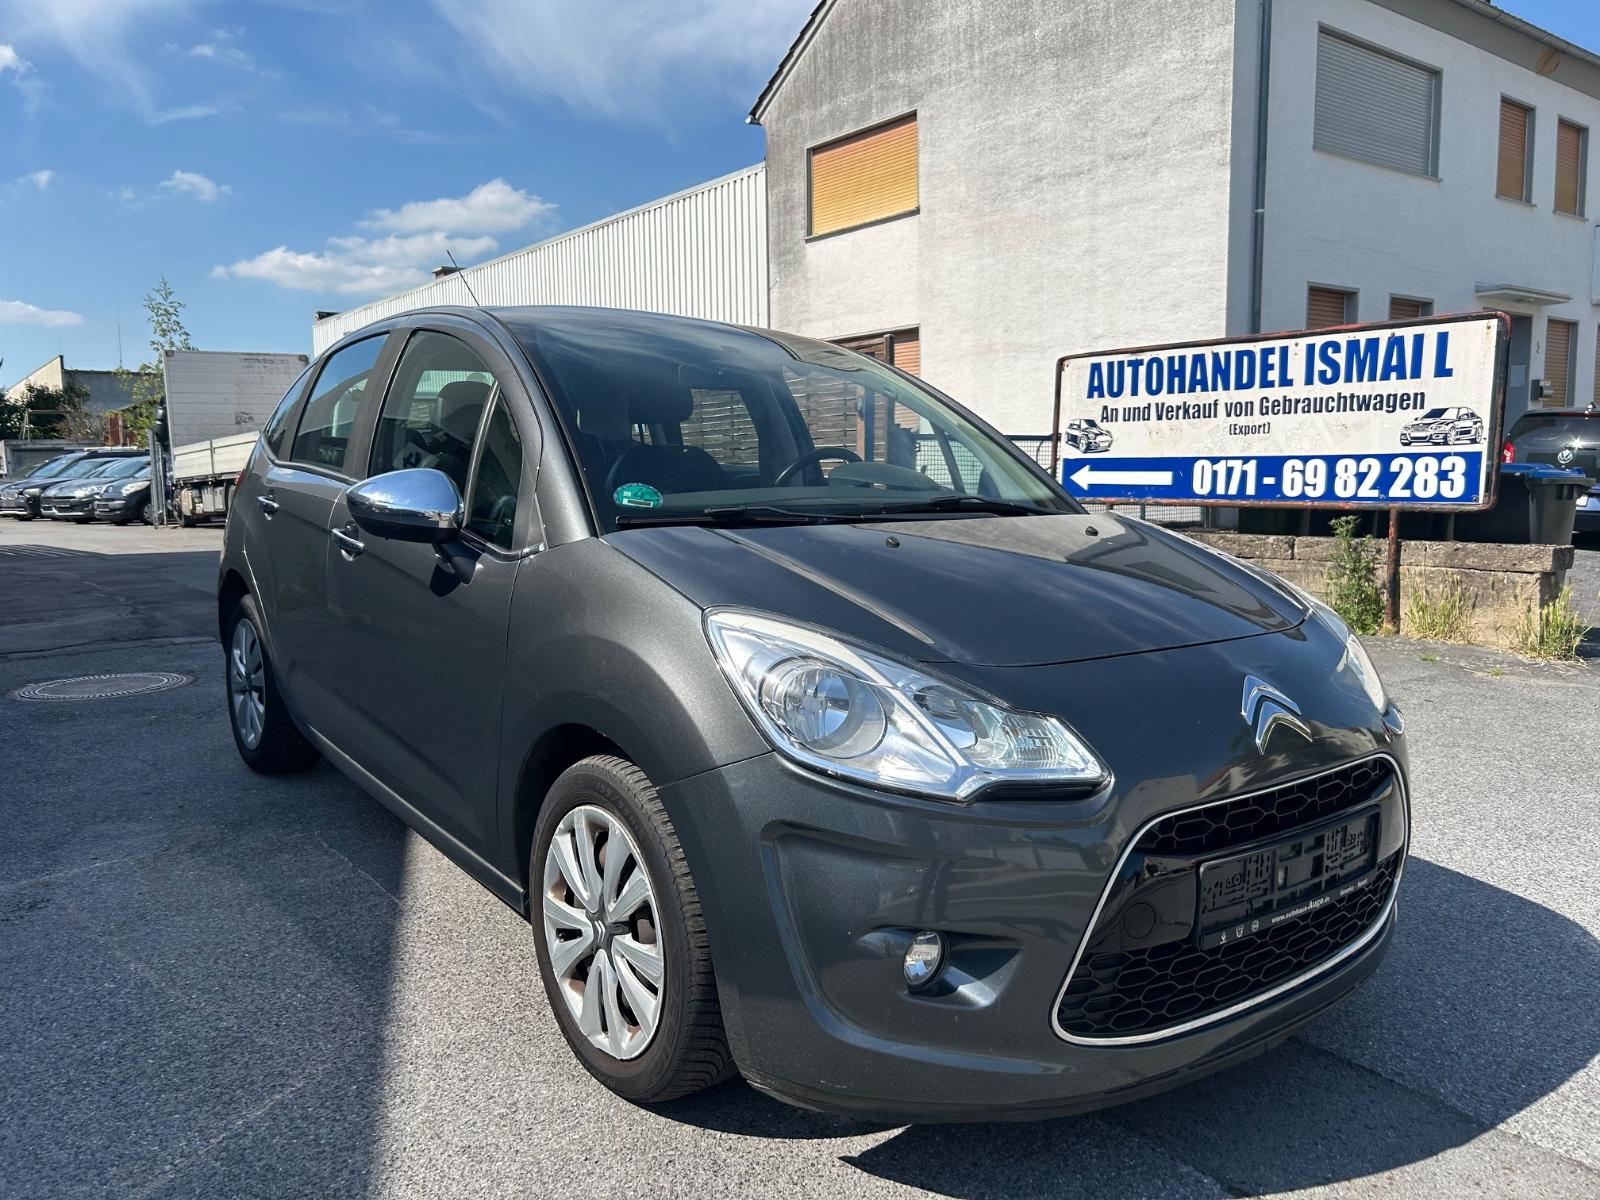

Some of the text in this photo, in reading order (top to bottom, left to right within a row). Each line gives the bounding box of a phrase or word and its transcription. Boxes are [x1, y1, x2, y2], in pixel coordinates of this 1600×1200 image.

[1086, 345, 1294, 399] AUTOHANDEL
[1100, 391, 1426, 423] An und Verkauf von Gebrauchtwagen
[1229, 422, 1271, 437] (Export)
[1192, 459, 1257, 496] 0171
[1282, 458, 1327, 498] 69
[1334, 457, 1381, 498] 82
[1388, 455, 1466, 498] 283
